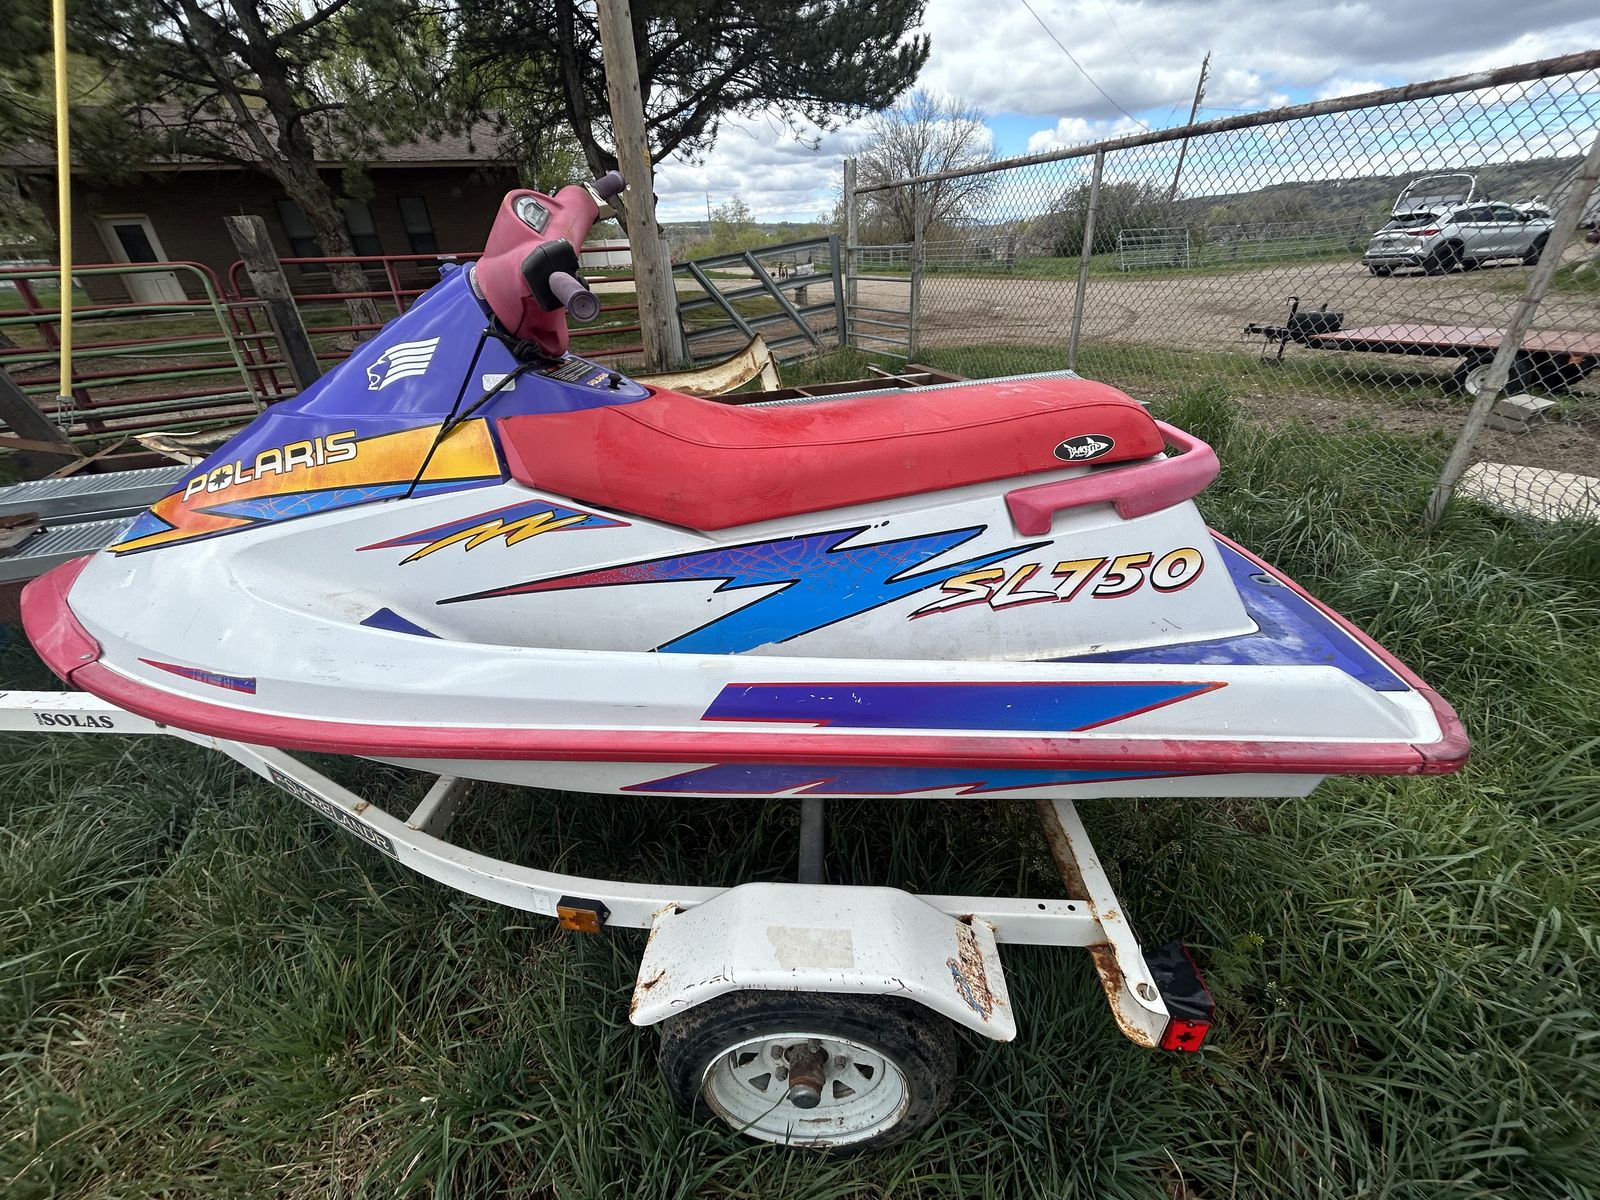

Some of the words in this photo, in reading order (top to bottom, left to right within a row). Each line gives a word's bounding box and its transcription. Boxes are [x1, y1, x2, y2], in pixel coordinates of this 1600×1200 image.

[182, 429, 358, 502] POLARIS
[906, 547, 1205, 621] SL750
[40, 712, 114, 729] SOLAS
